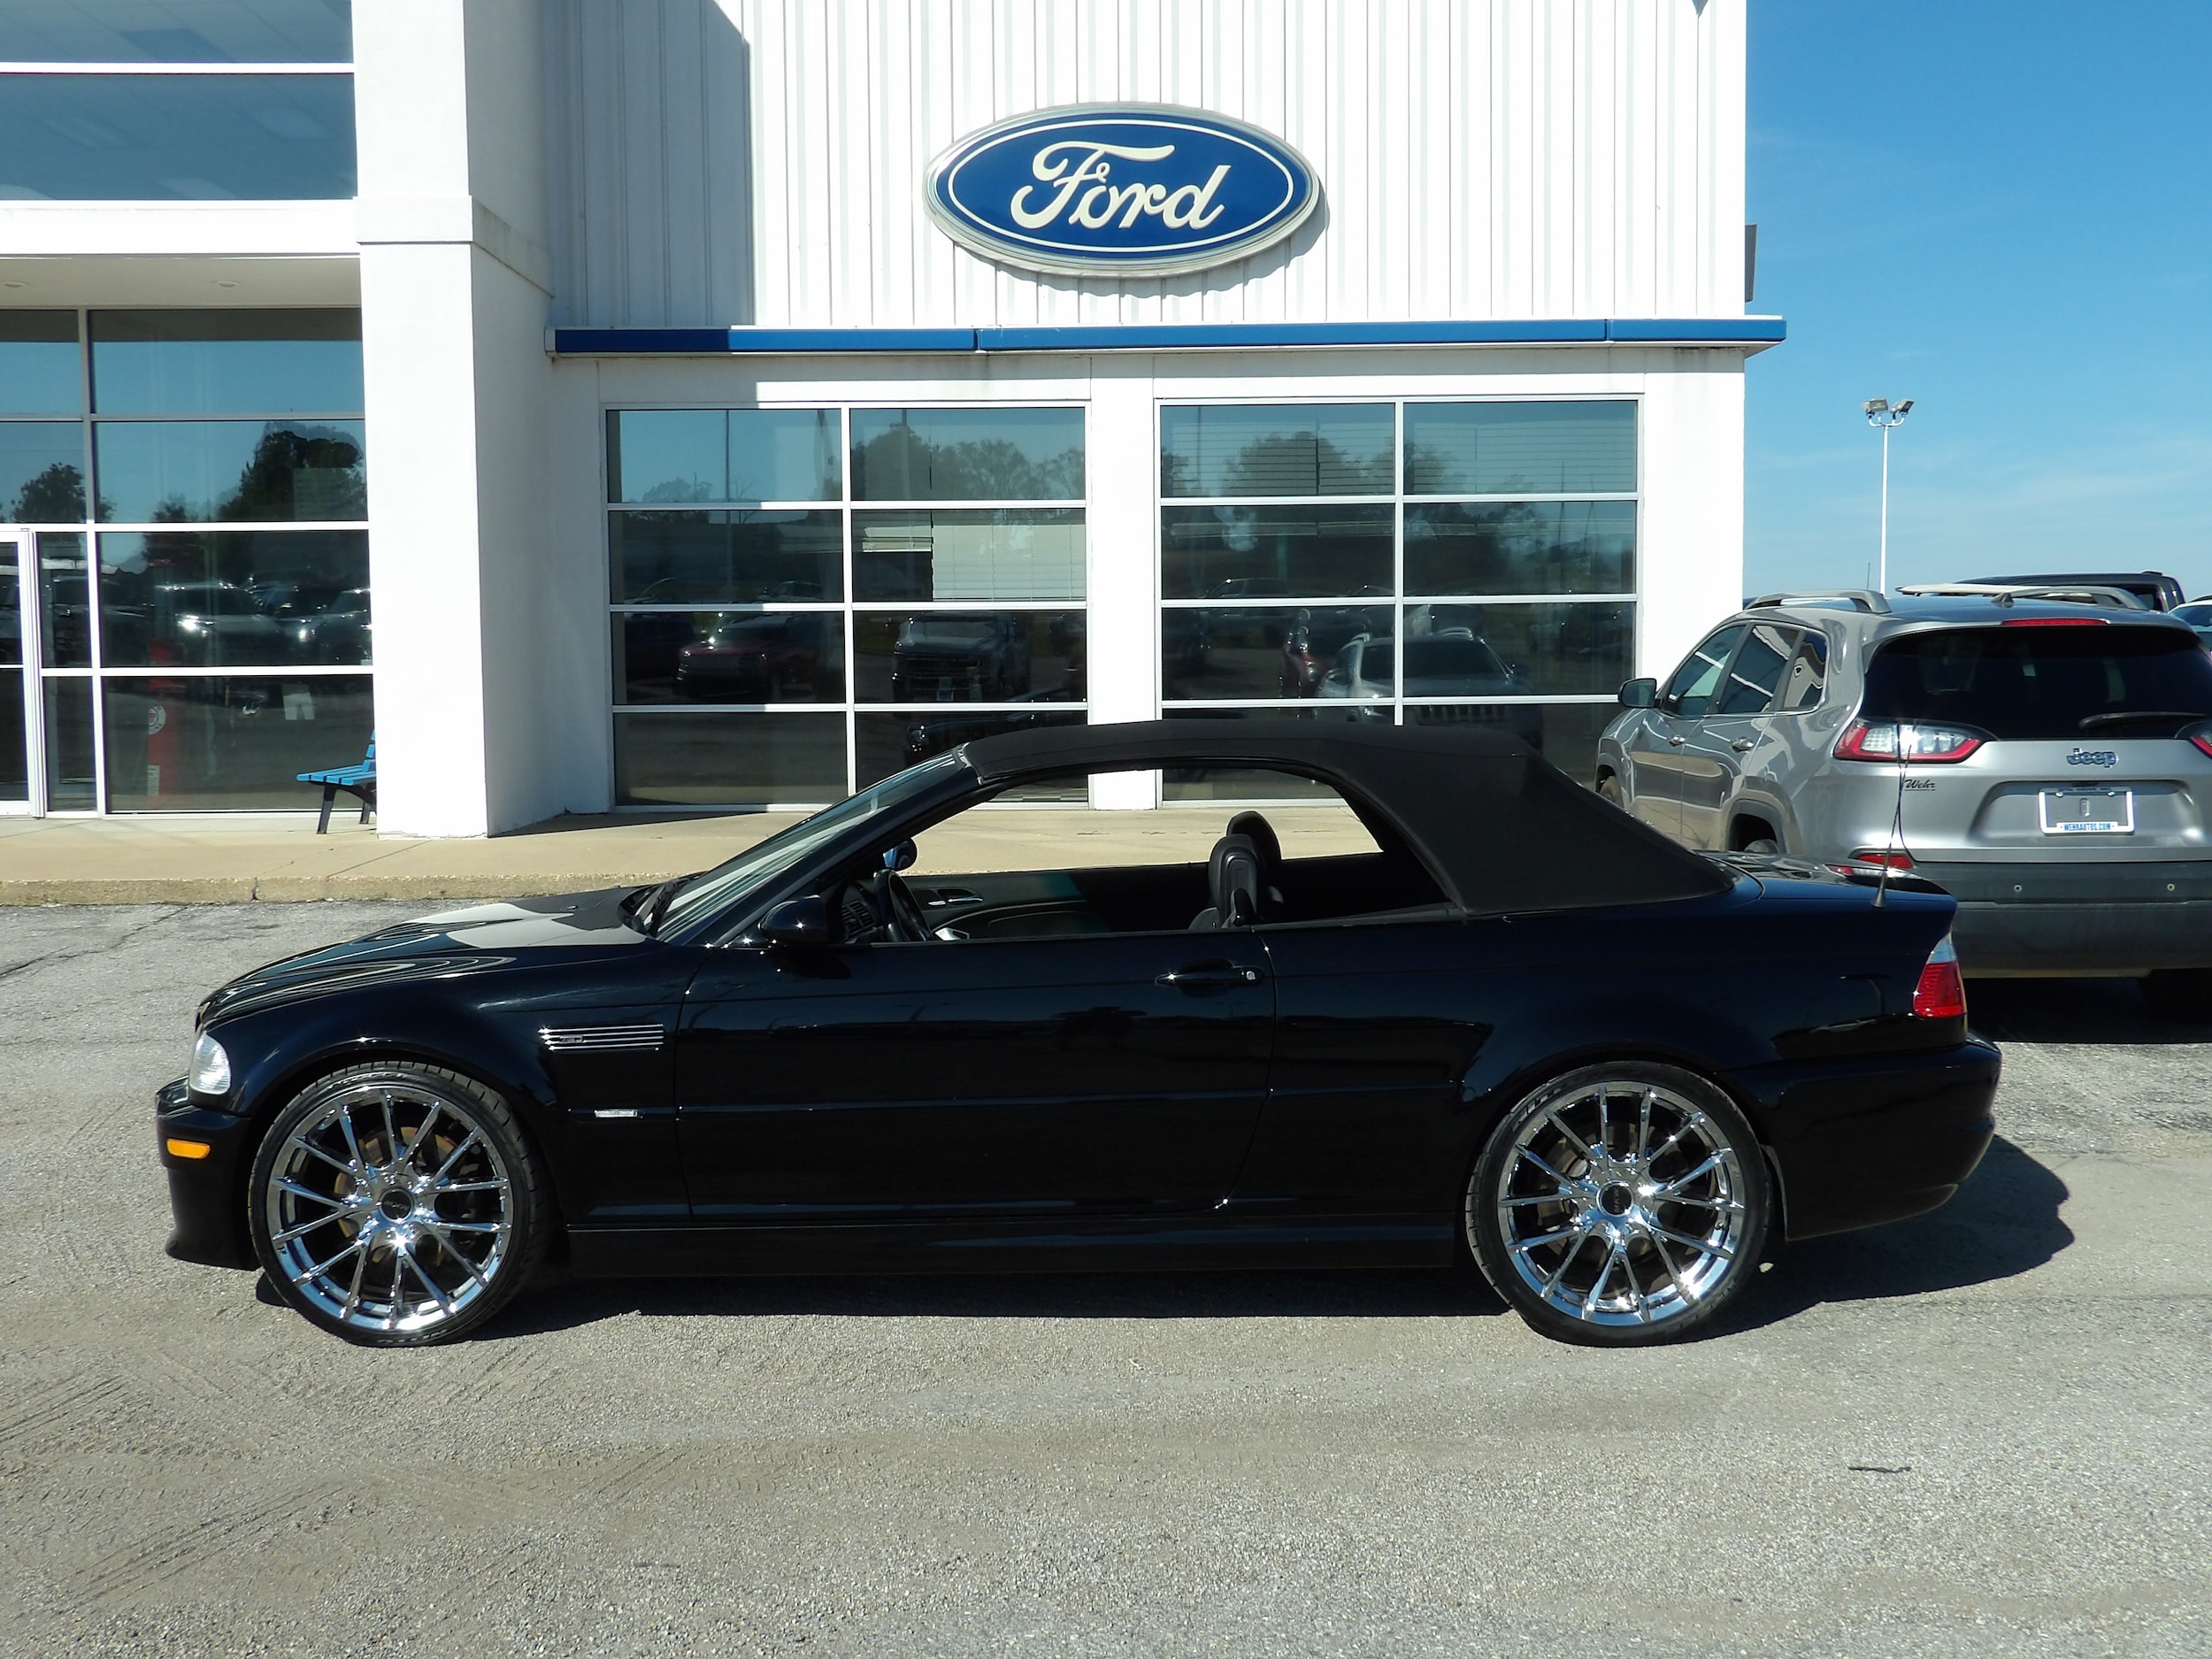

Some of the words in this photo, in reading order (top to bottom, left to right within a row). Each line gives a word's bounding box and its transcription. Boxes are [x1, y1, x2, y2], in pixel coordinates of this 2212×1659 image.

[1010, 141, 1231, 230] Ford
[2066, 748, 2117, 768] Jeep
[1904, 779, 1935, 789] Wehr
